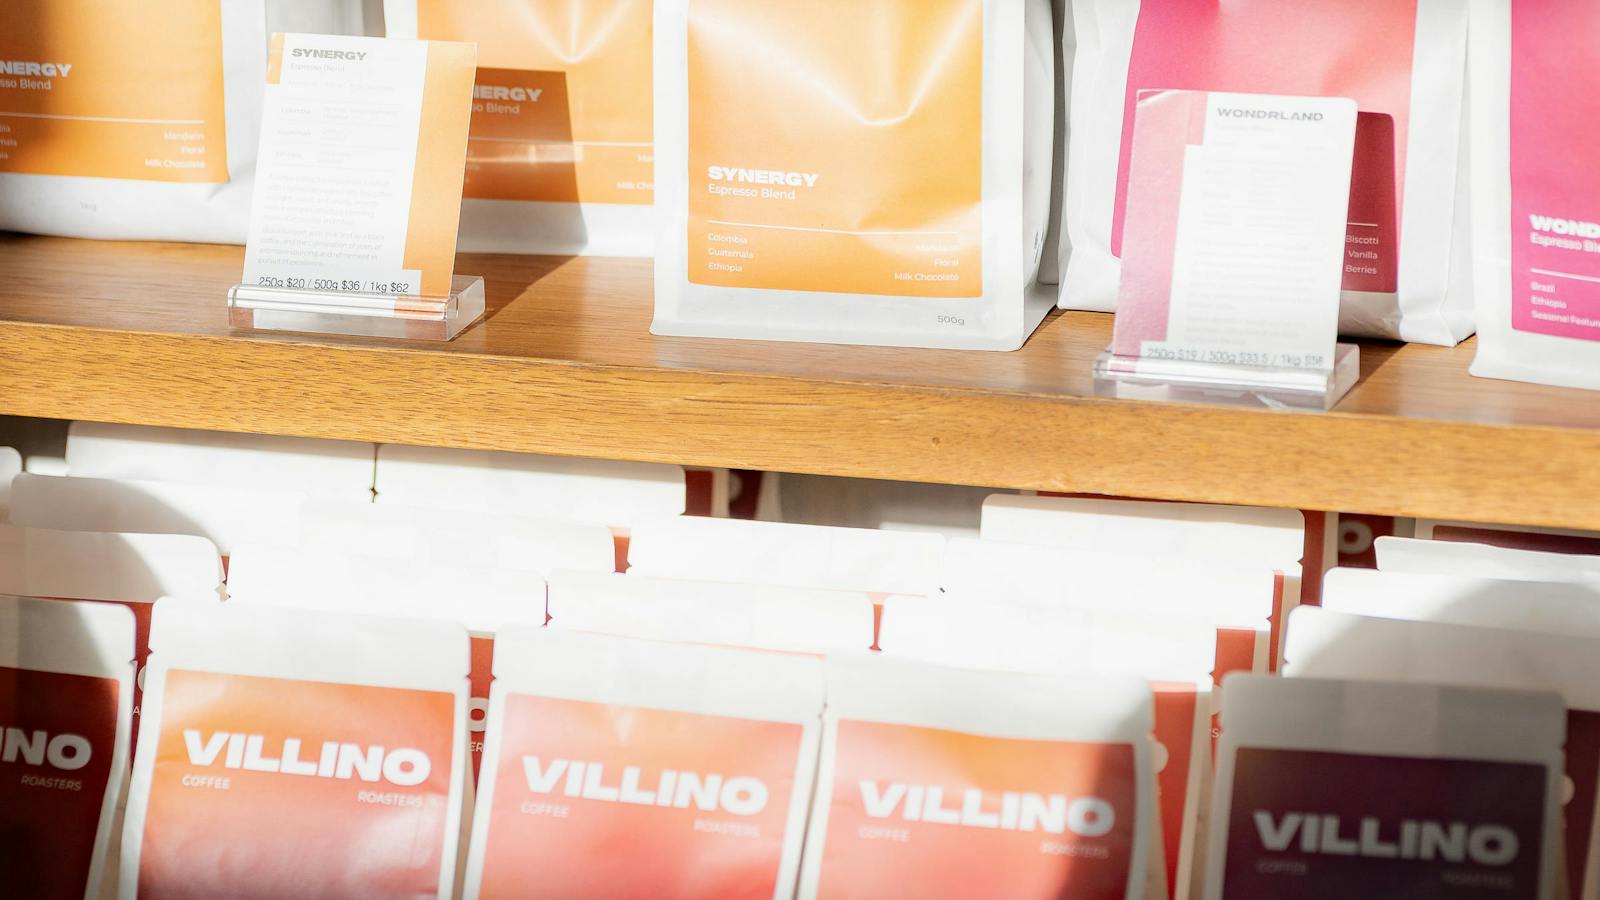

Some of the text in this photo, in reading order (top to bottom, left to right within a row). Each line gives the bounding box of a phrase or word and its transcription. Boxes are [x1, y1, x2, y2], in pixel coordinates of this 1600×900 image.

[291, 48, 367, 61] SYNERGY
[21, 80, 52, 90] Blend
[486, 103, 520, 114] Blend
[1217, 107, 1324, 121] WONDRLAND
[708, 165, 819, 188] SYNERGY
[708, 183, 796, 200] Espresso Blend
[708, 232, 748, 245] Colombia
[1345, 234, 1379, 245] Biscotti
[1530, 232, 1582, 251] Espresso
[708, 247, 754, 259] Guatemala
[1348, 250, 1378, 260] Vanilla
[708, 261, 743, 273] Ethiopia
[1345, 264, 1377, 275] Berries
[894, 271, 960, 281] Milk Chocolate
[258, 276, 283, 288] 250g
[287, 277, 305, 289] $20
[314, 279, 338, 291] 500g
[342, 279, 360, 291] $36
[371, 281, 387, 293] 1kg
[391, 281, 409, 293] $62
[937, 314, 965, 326] 500g
[183, 729, 432, 787] VILLINO
[21, 775, 82, 791] ROASTERS
[182, 774, 230, 790] COFFEE
[522, 754, 769, 816] VILLINO
[358, 790, 424, 808] ROASTERS
[521, 801, 569, 818] COFFEE
[858, 779, 1115, 838] VILLINO
[694, 819, 760, 839] ROASTERS
[858, 825, 910, 843] COFFEE
[1253, 810, 1519, 866] VILLINO
